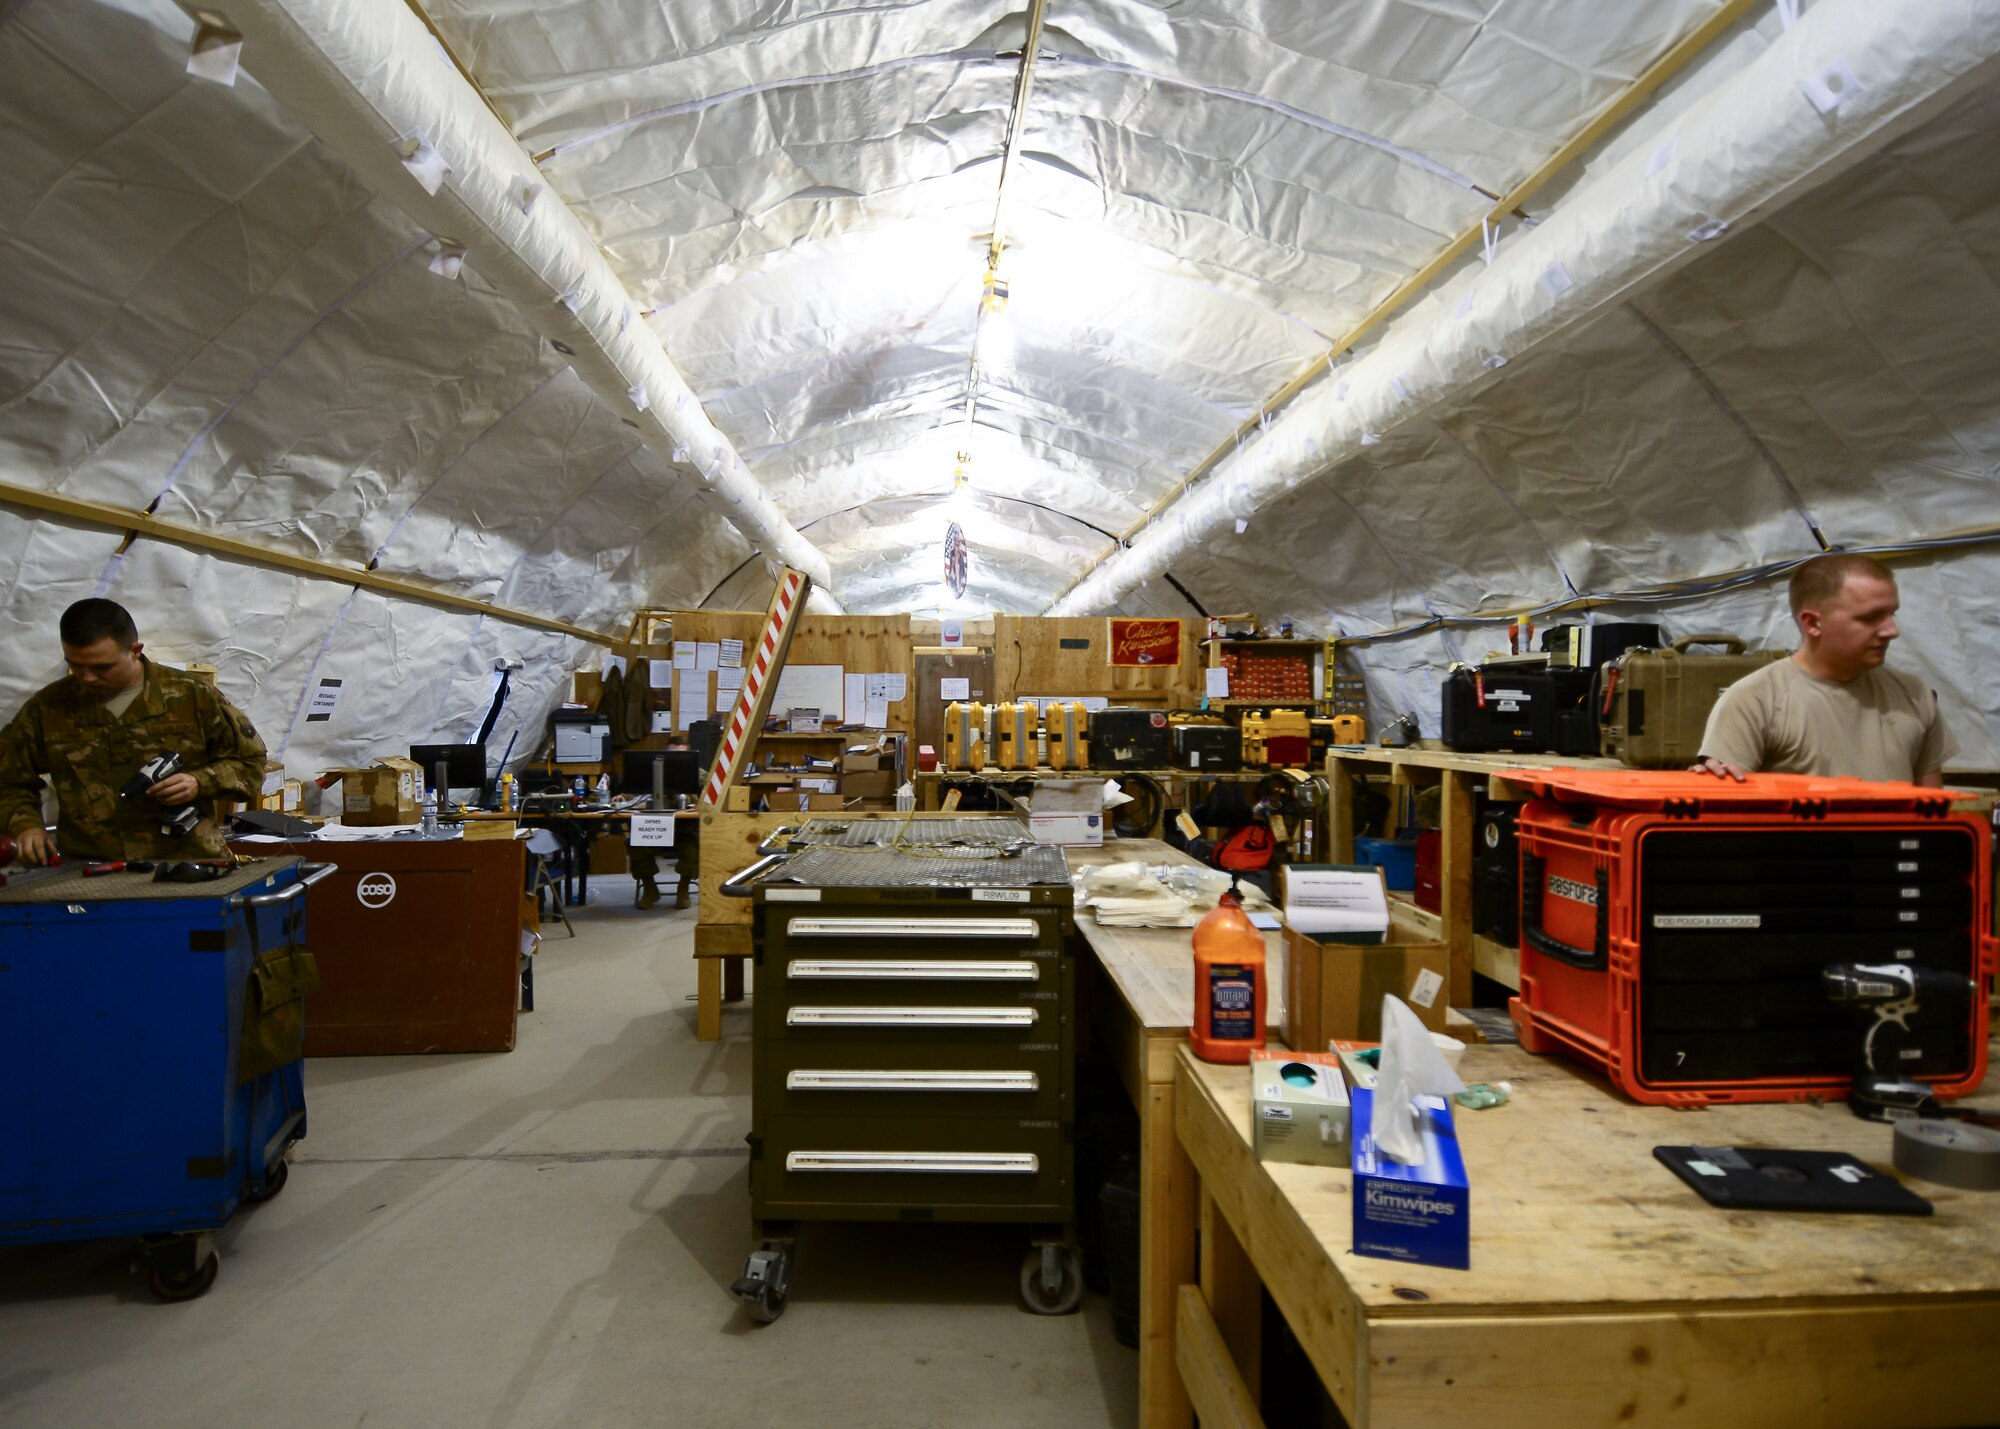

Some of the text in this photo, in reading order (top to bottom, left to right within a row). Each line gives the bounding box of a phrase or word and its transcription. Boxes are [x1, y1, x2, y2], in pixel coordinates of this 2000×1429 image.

[1125, 622, 1168, 639] Chiefs
[1117, 635, 1174, 655] Kingdom
[1677, 1052, 1686, 1066] 7
[1366, 1190, 1455, 1216] Kimwipes
